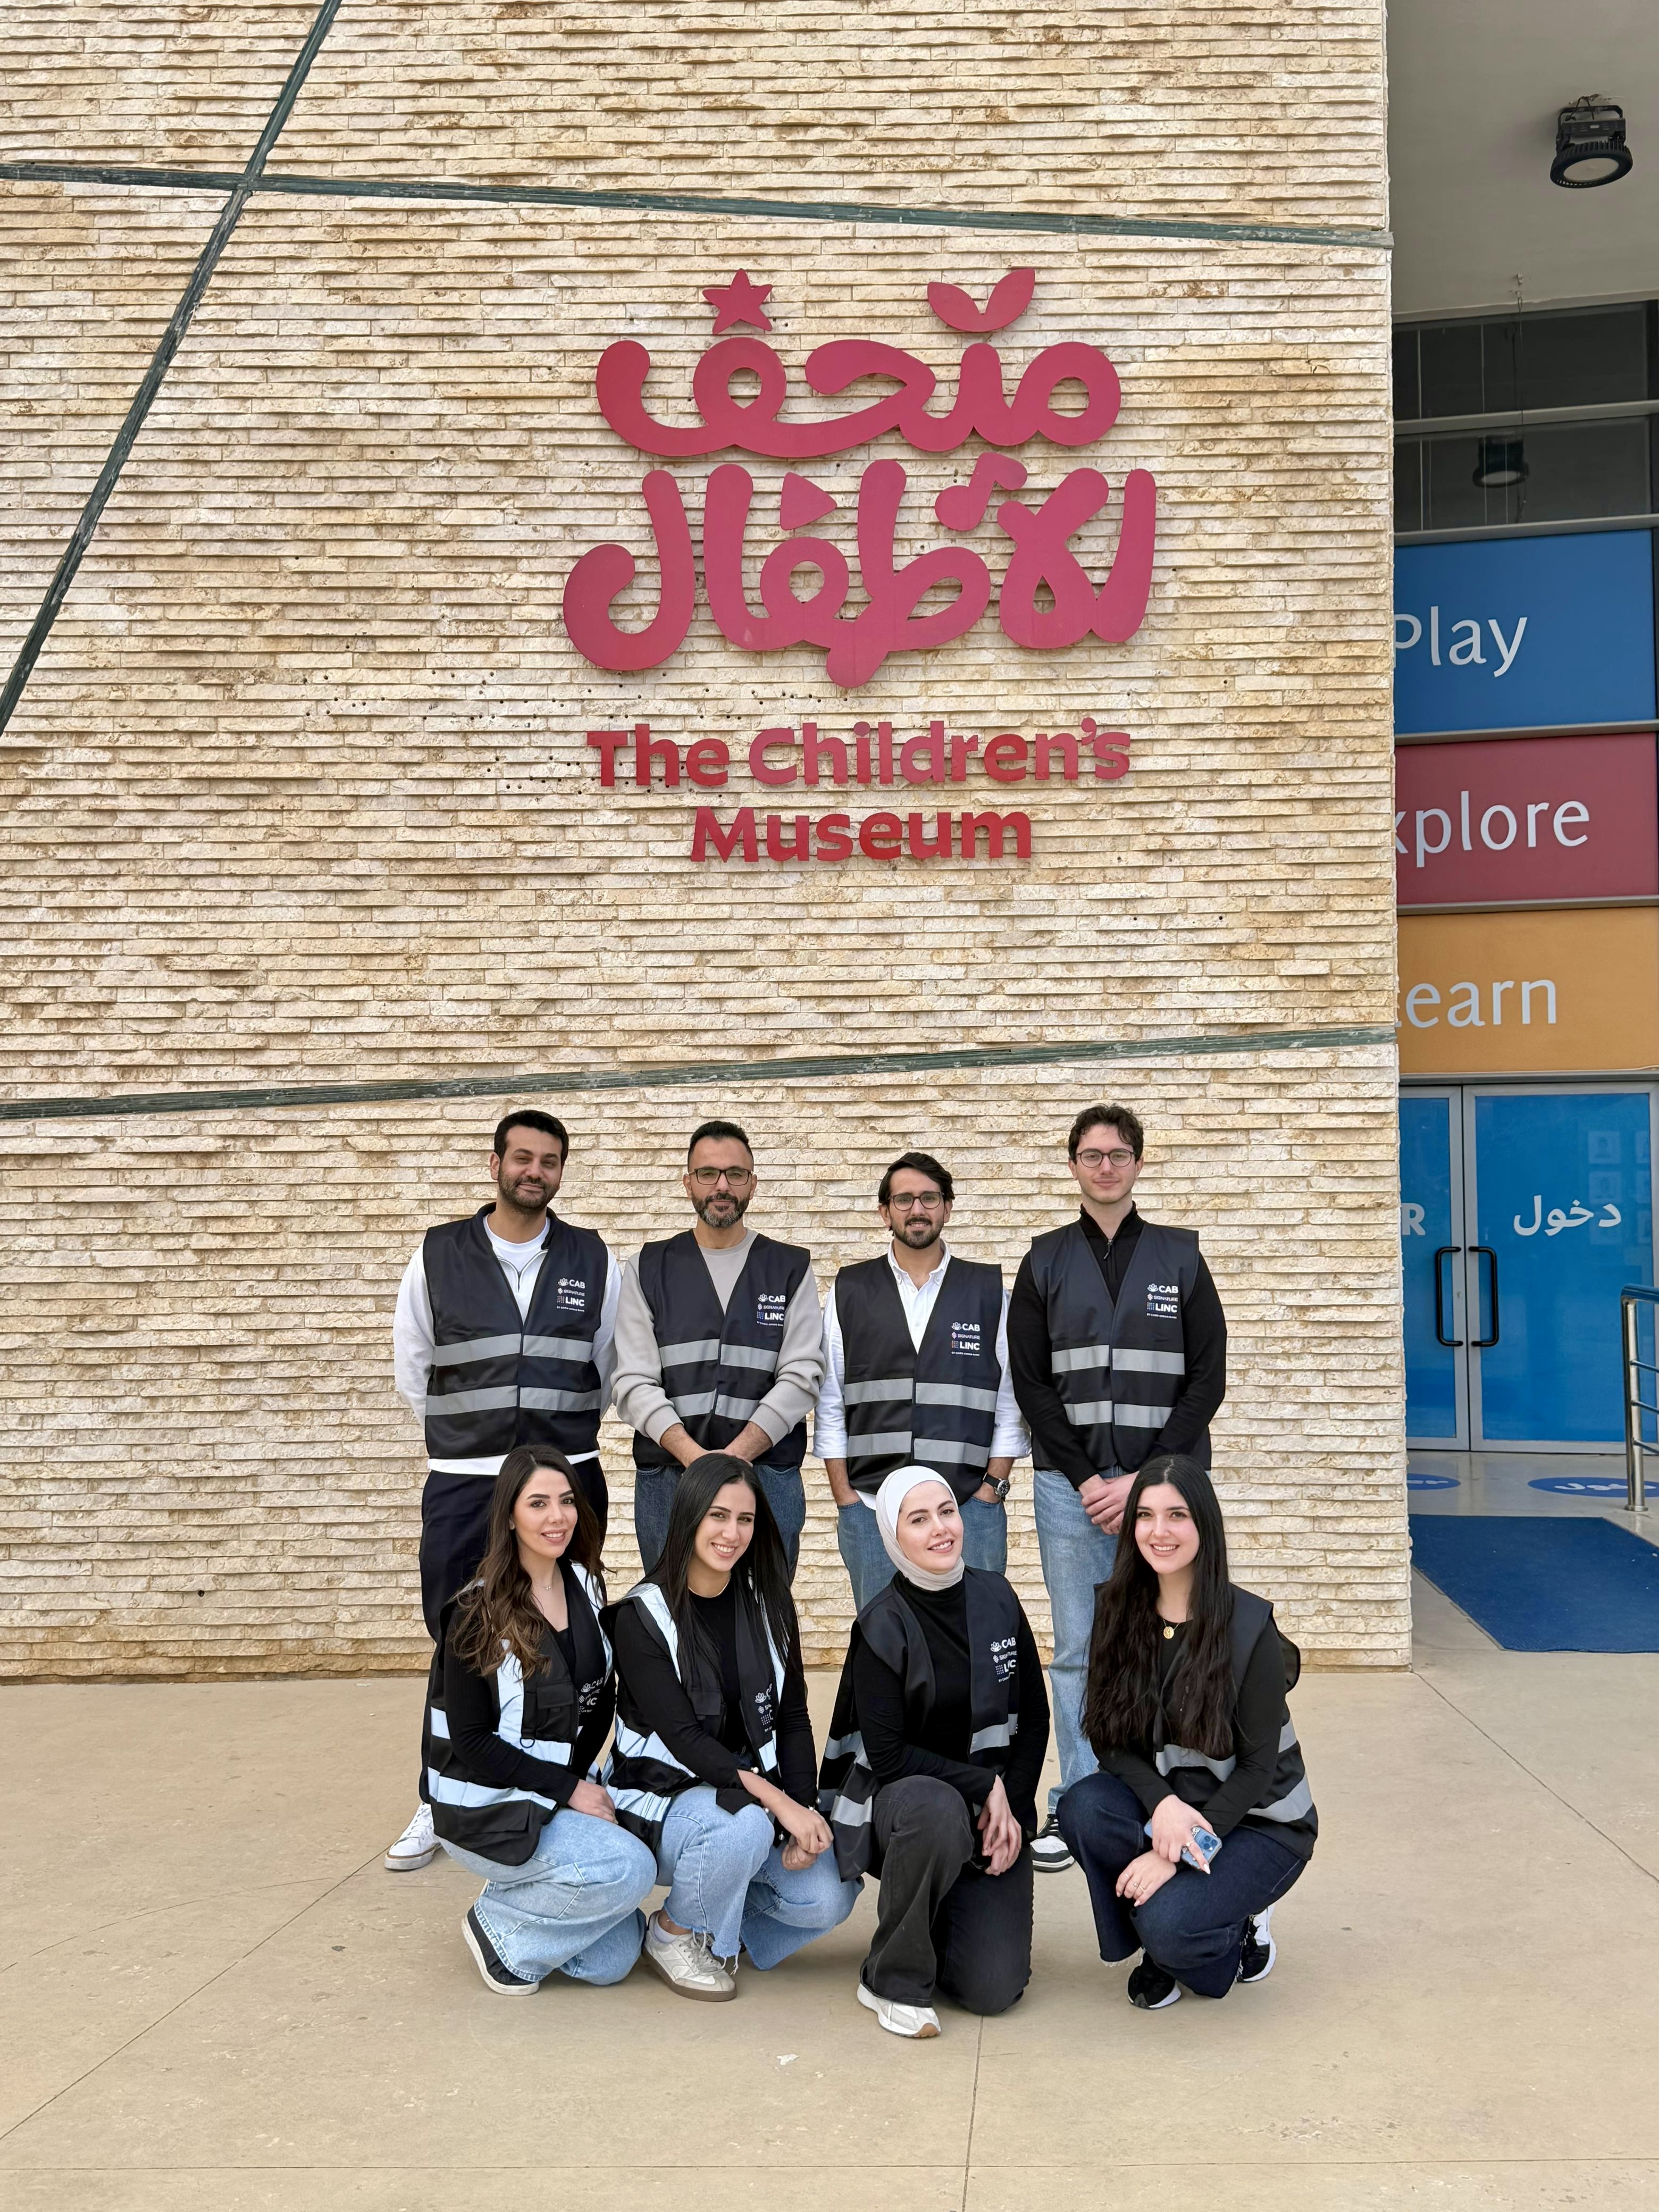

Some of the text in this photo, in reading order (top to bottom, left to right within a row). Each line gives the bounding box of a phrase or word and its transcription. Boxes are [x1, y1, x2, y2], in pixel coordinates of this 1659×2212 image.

[596, 269, 1121, 457] متحف
[1394, 606, 1527, 677] Play
[587, 717, 1130, 787] The Children's
[691, 807, 1031, 862] Museum
[1395, 791, 1589, 868] xplore
[1395, 979, 1556, 1028] earn
[1514, 1195, 1621, 1236] دخول
[565, 1296, 584, 1306] LINC
[569, 1279, 585, 1289] CAB
[765, 1312, 784, 1321] LINC
[1155, 1303, 1178, 1313] LINC
[960, 1341, 980, 1350] LINC
[1001, 1637, 1016, 1648] CAB
